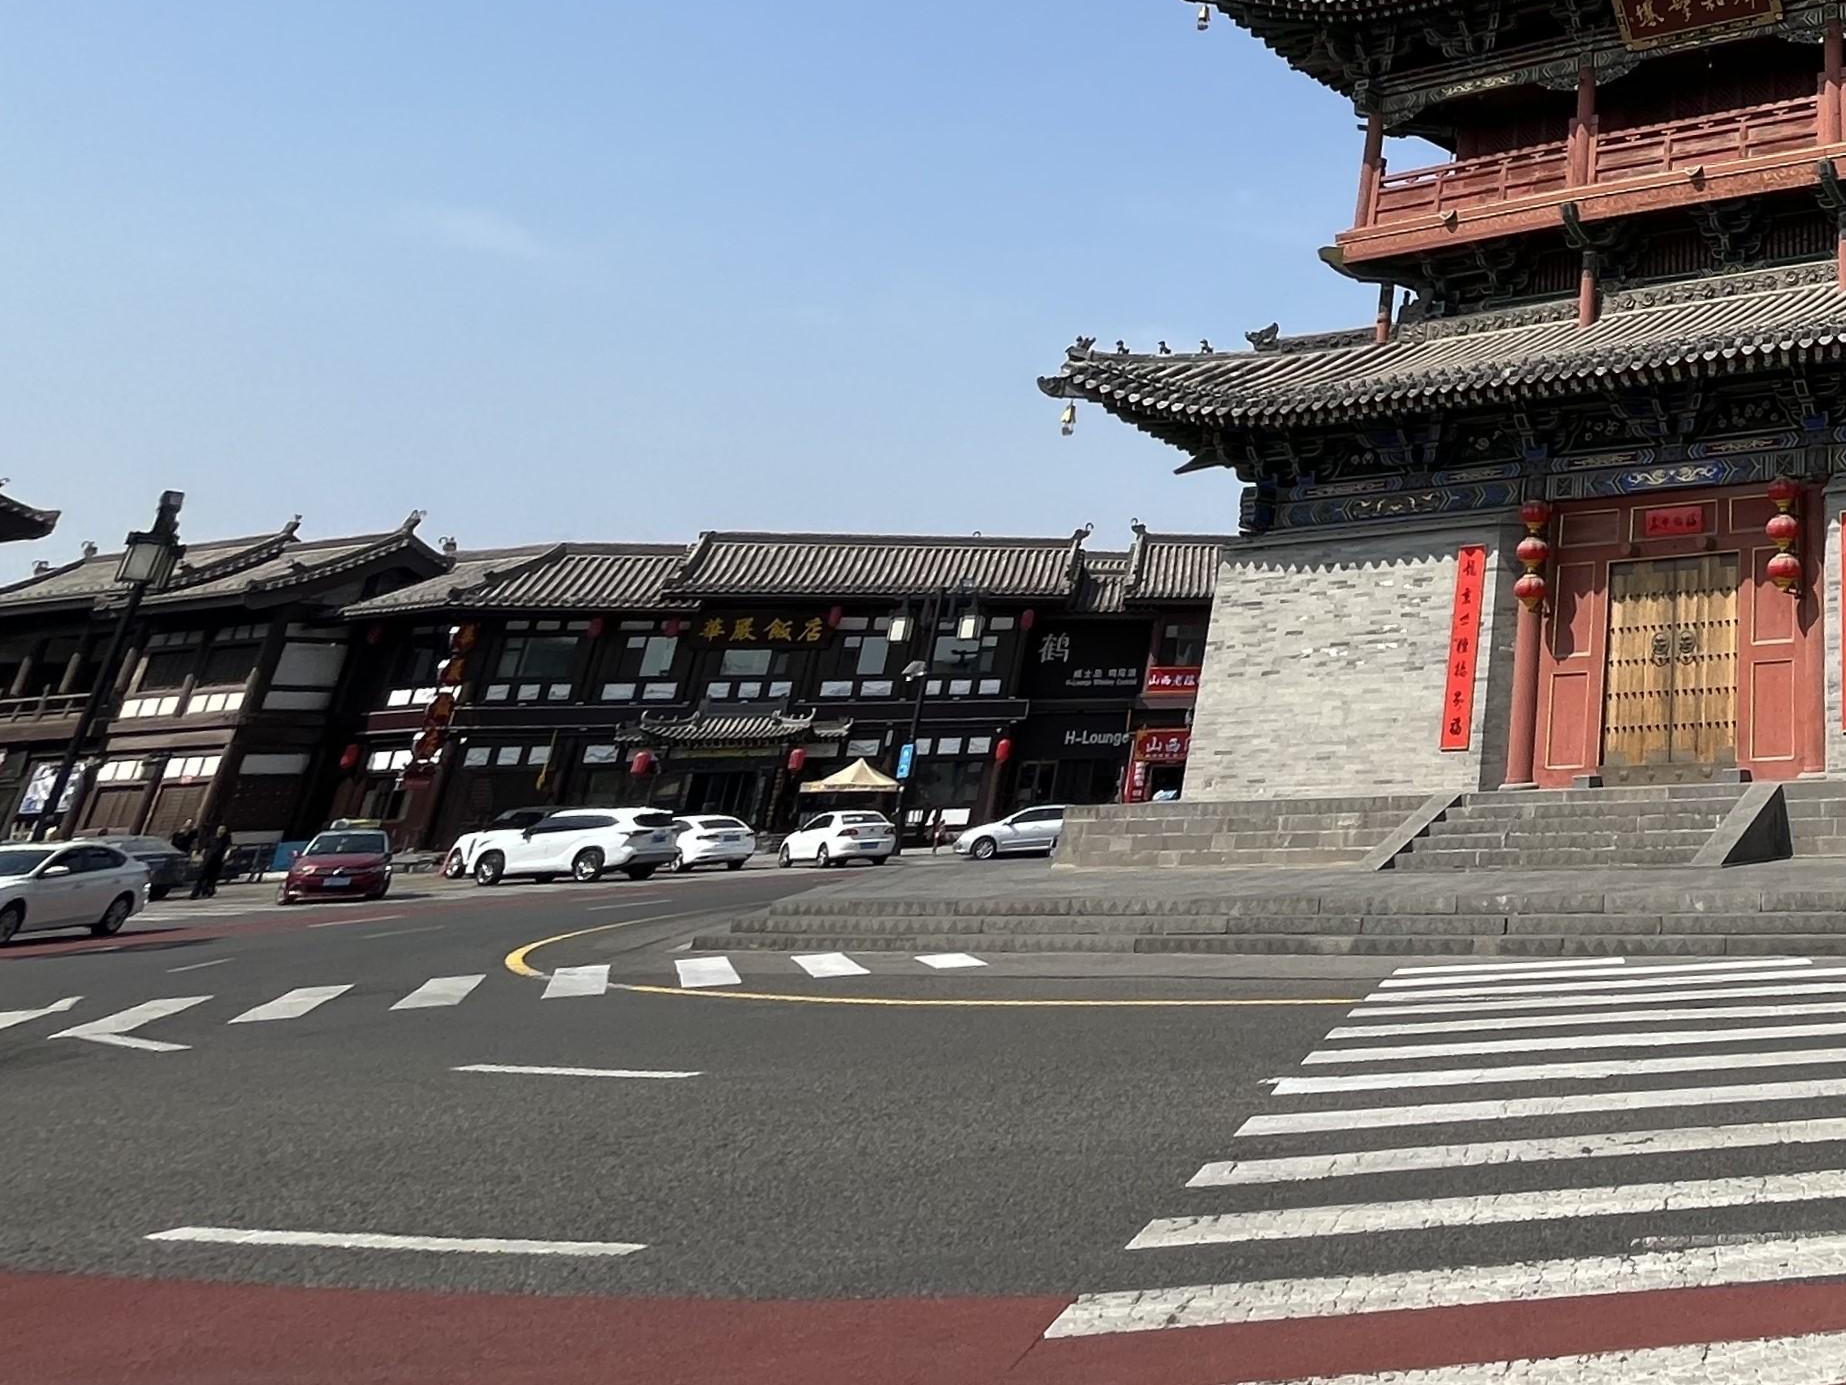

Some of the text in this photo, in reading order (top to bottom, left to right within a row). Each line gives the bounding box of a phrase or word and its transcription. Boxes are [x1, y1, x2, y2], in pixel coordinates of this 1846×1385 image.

[1038, 632, 1071, 663] 鹤
[1064, 729, 1130, 747] H-Lounge
[1145, 736, 1190, 753] 山西
